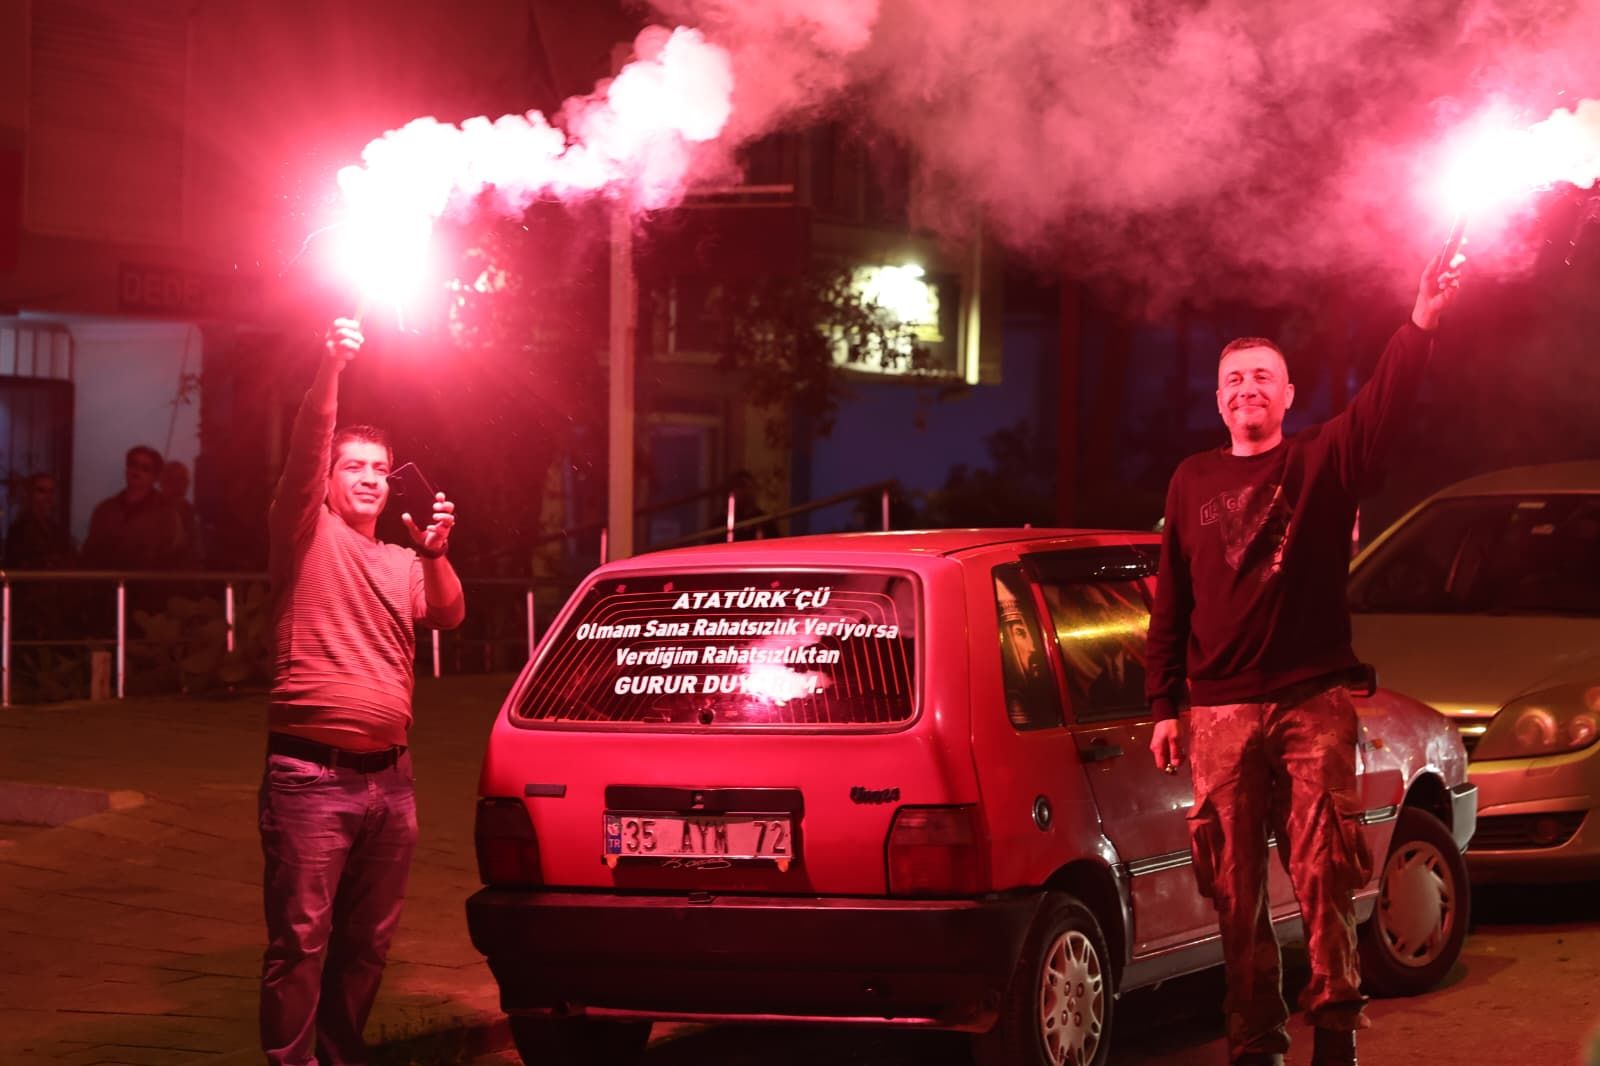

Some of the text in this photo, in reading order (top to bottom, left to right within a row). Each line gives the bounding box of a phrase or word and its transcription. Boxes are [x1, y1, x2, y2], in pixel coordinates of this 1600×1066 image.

[672, 587, 830, 610] ATATÜRK'ÇÜ
[576, 618, 898, 641] Olmam Sana Rahatsızlık Veriyorsa
[616, 646, 840, 669] Verdiğim Rahatsızlıktan
[614, 675, 698, 694] GURUR
[608, 838, 621, 848] TR
[626, 820, 657, 852] 35
[753, 821, 787, 854] 72
